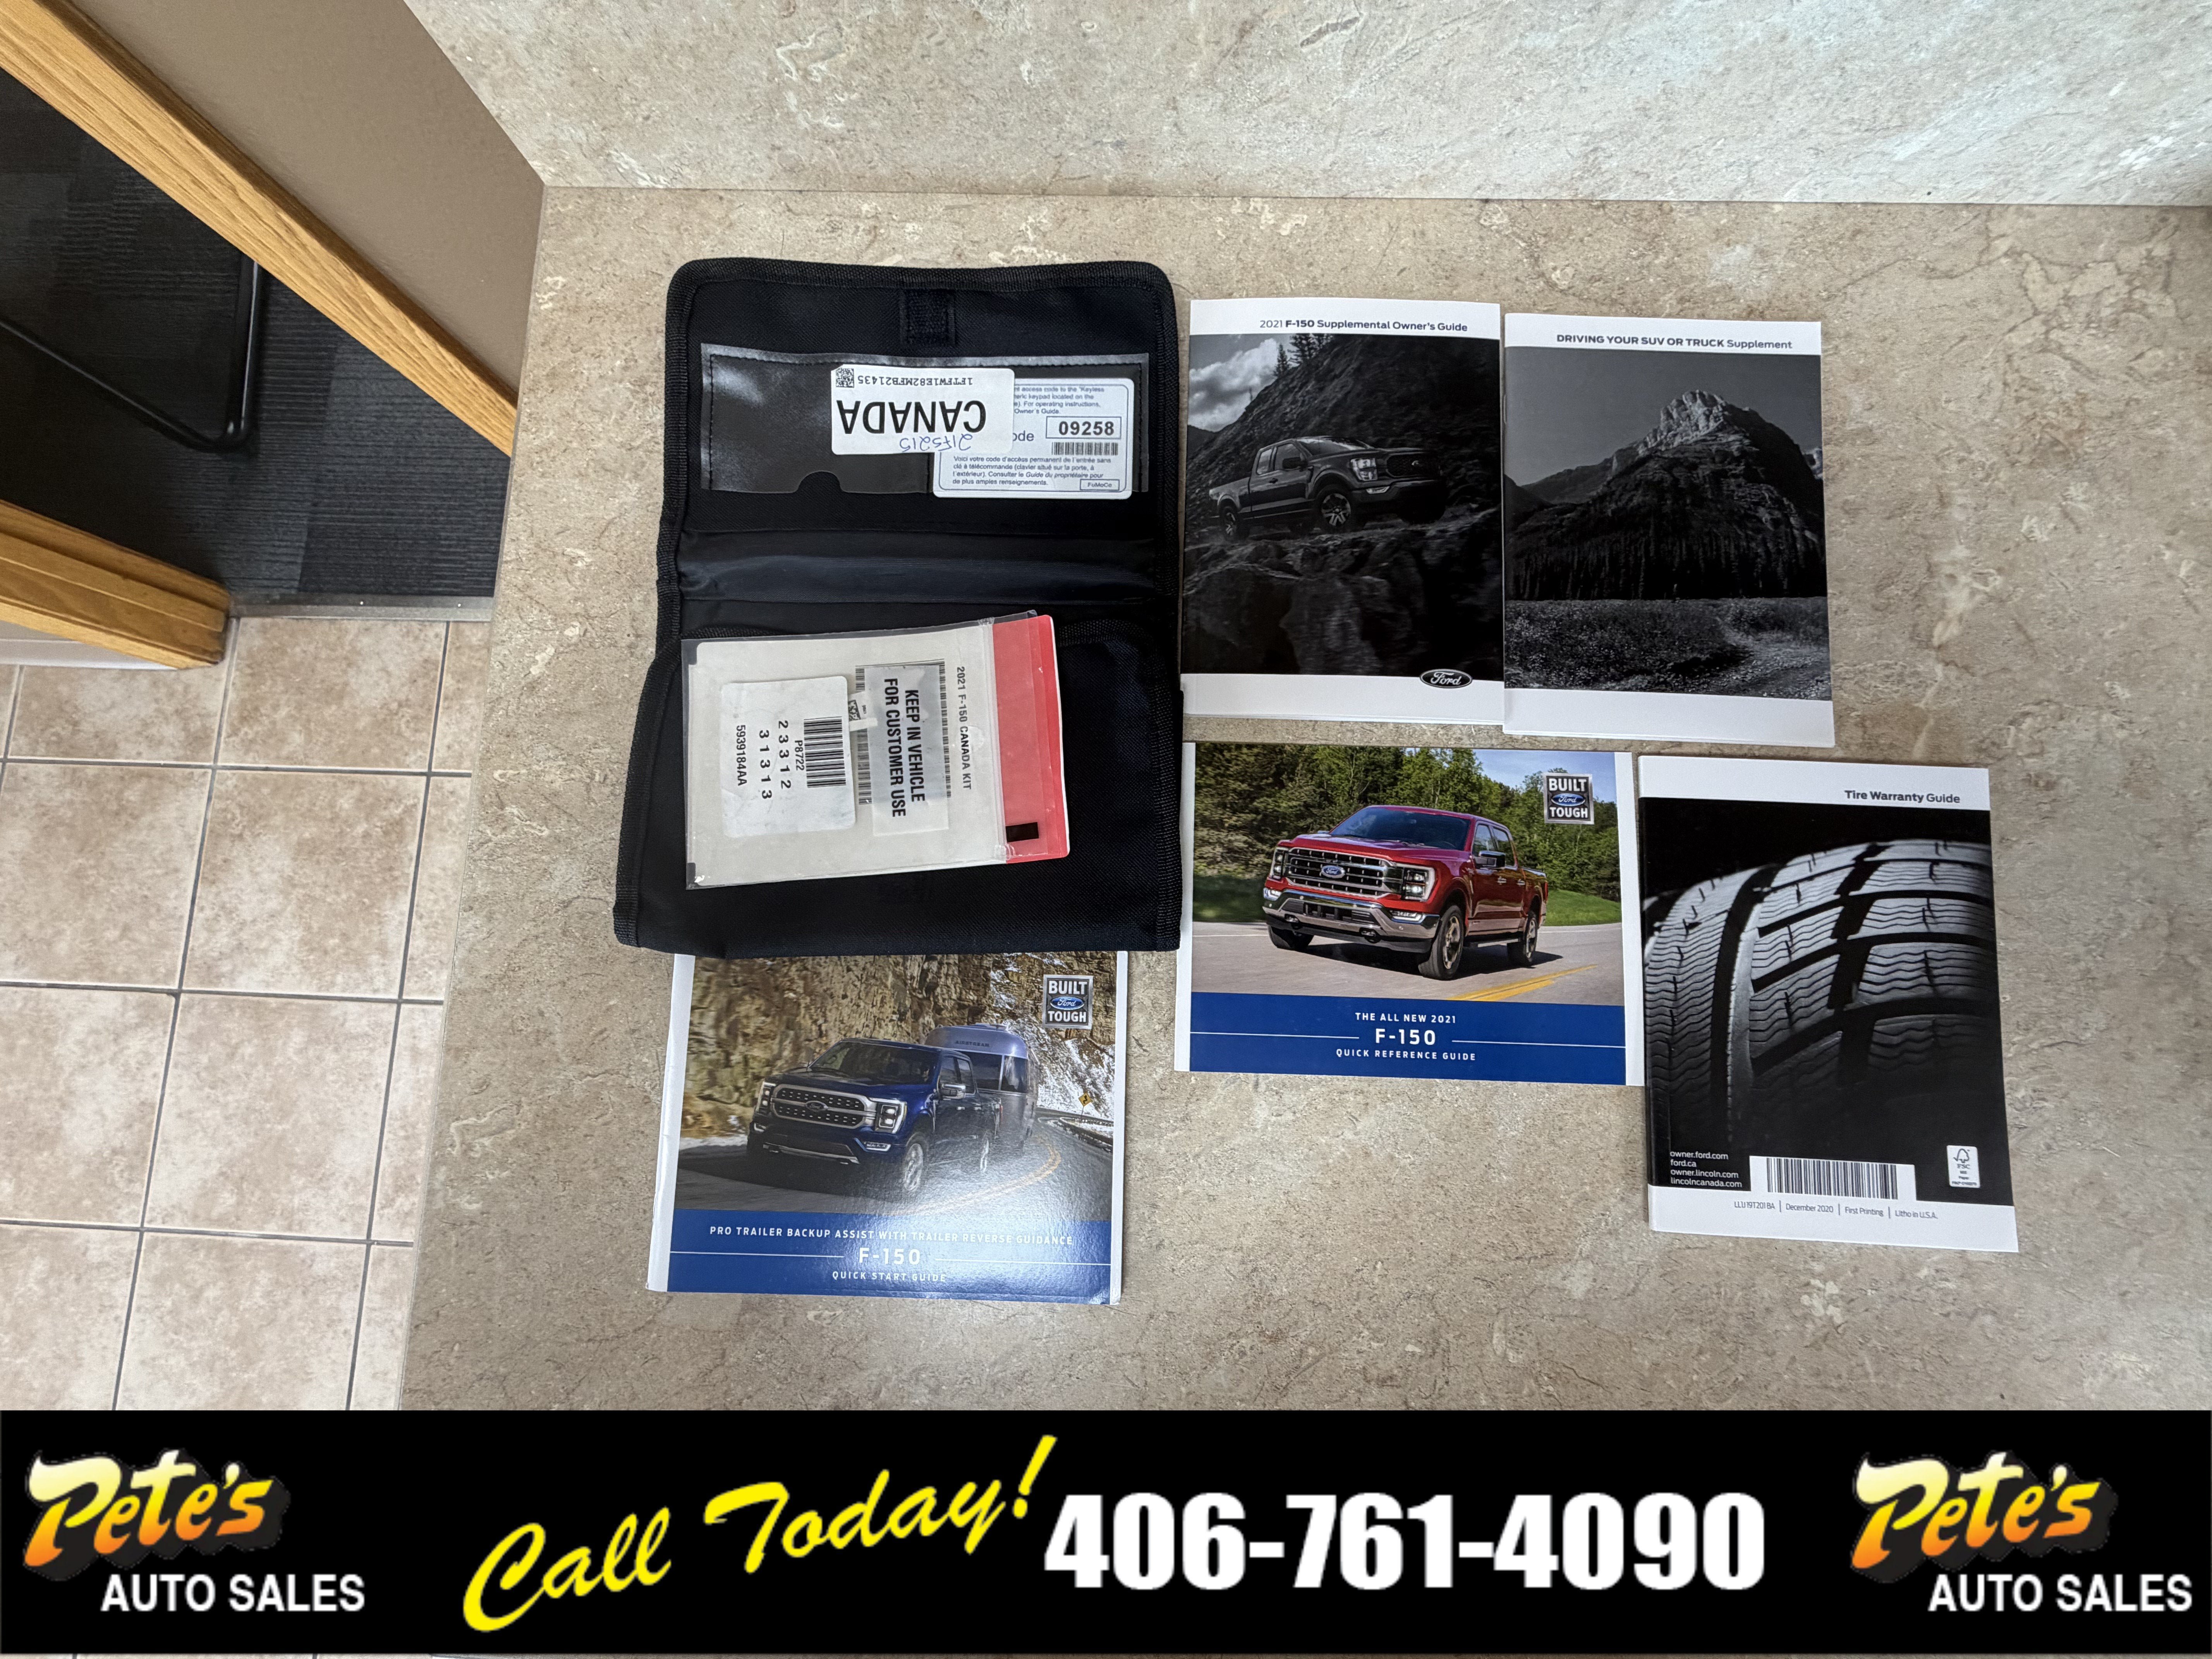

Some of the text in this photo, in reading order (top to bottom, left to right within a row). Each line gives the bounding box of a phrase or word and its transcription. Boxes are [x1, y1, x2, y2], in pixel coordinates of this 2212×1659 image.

[1260, 320, 1282, 328] 2021
[1317, 320, 1390, 329] Supplemental
[1393, 321, 1435, 330] Owner's
[1437, 323, 1468, 331] Guide
[1557, 335, 1793, 349] DRIVING YOUR SUV OR TRUCK Supplement
[858, 375, 973, 385] 1FTFW1E82MFB21435
[836, 400, 986, 434] CANADA
[1059, 421, 1114, 435] 09258
[1012, 430, 1034, 441] ode
[957, 666, 971, 789] 2021 F-150 CANADA KIT
[884, 678, 906, 817] FOR CUSTOMER USE
[905, 690, 925, 802] KEEP IN VEHICLE
[736, 725, 747, 786] 5939184AA
[795, 740, 805, 771] P8722
[1549, 778, 1587, 792] BUILT
[1844, 790, 1960, 803] Tire Warranty Guide
[1549, 807, 1588, 818] TOUGH
[1049, 981, 1087, 994] BUILT
[1057, 998, 1077, 1006] Ford
[1048, 1011, 1086, 1022] TOUGH
[1355, 1012, 1456, 1024] THE ALL NEW 2021
[1376, 1028, 1436, 1045] F-150
[1336, 1049, 1475, 1061] QUICK REFERENCE GUIDE
[1670, 1151, 1729, 1160] owner.ford.com
[1670, 1159, 1697, 1167] ford.ca
[1670, 1169, 1739, 1178] owner.lincoln.com
[1671, 1177, 1742, 1187] lincolncanada.com
[1786, 1203, 1816, 1211] December
[1860, 1207, 1884, 1217] Printing
[710, 1226, 1072, 1245] PRO TRAILER BACKUP ASSIST WITH TRAILER REVERSE GUIDANCE
[859, 1247, 921, 1265] F-150
[832, 1271, 946, 1282] QUICK START GUIDE
